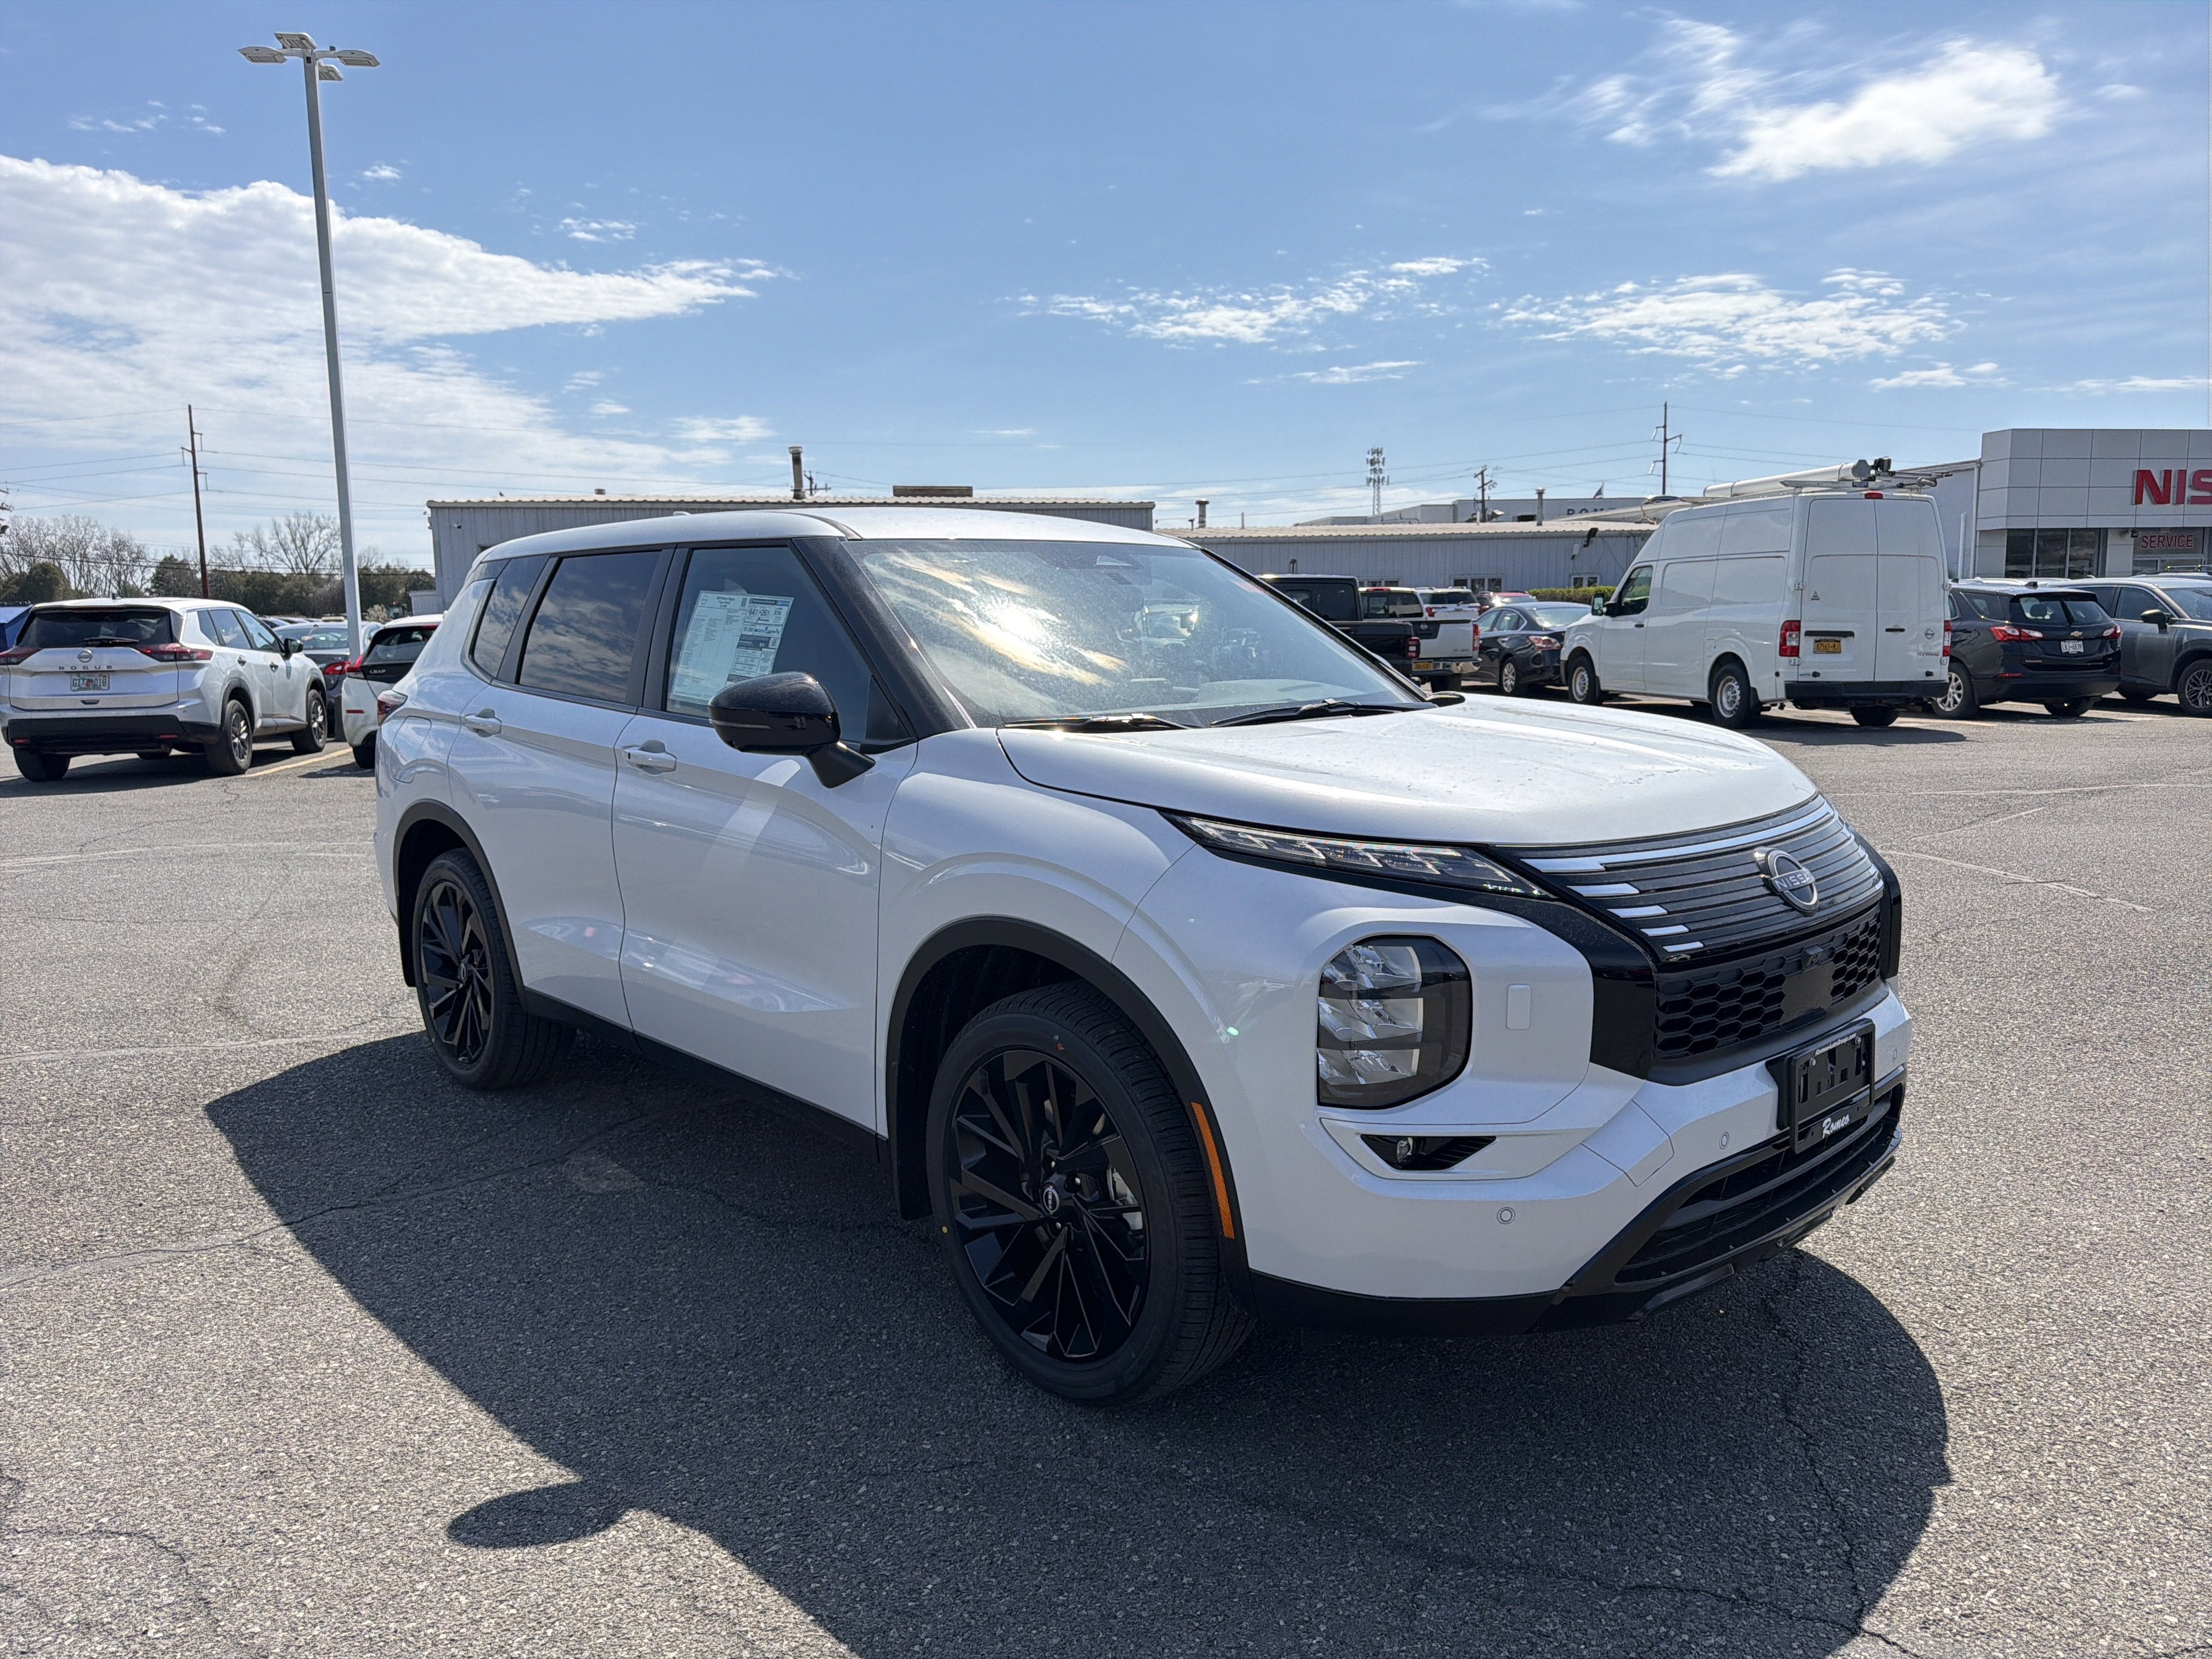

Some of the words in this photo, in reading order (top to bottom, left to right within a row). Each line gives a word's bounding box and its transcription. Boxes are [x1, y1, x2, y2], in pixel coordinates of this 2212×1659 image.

[2141, 534, 2193, 549] SERVICE
[1774, 871, 1814, 890] NISSA
[1822, 1114, 1850, 1139] Romeo
